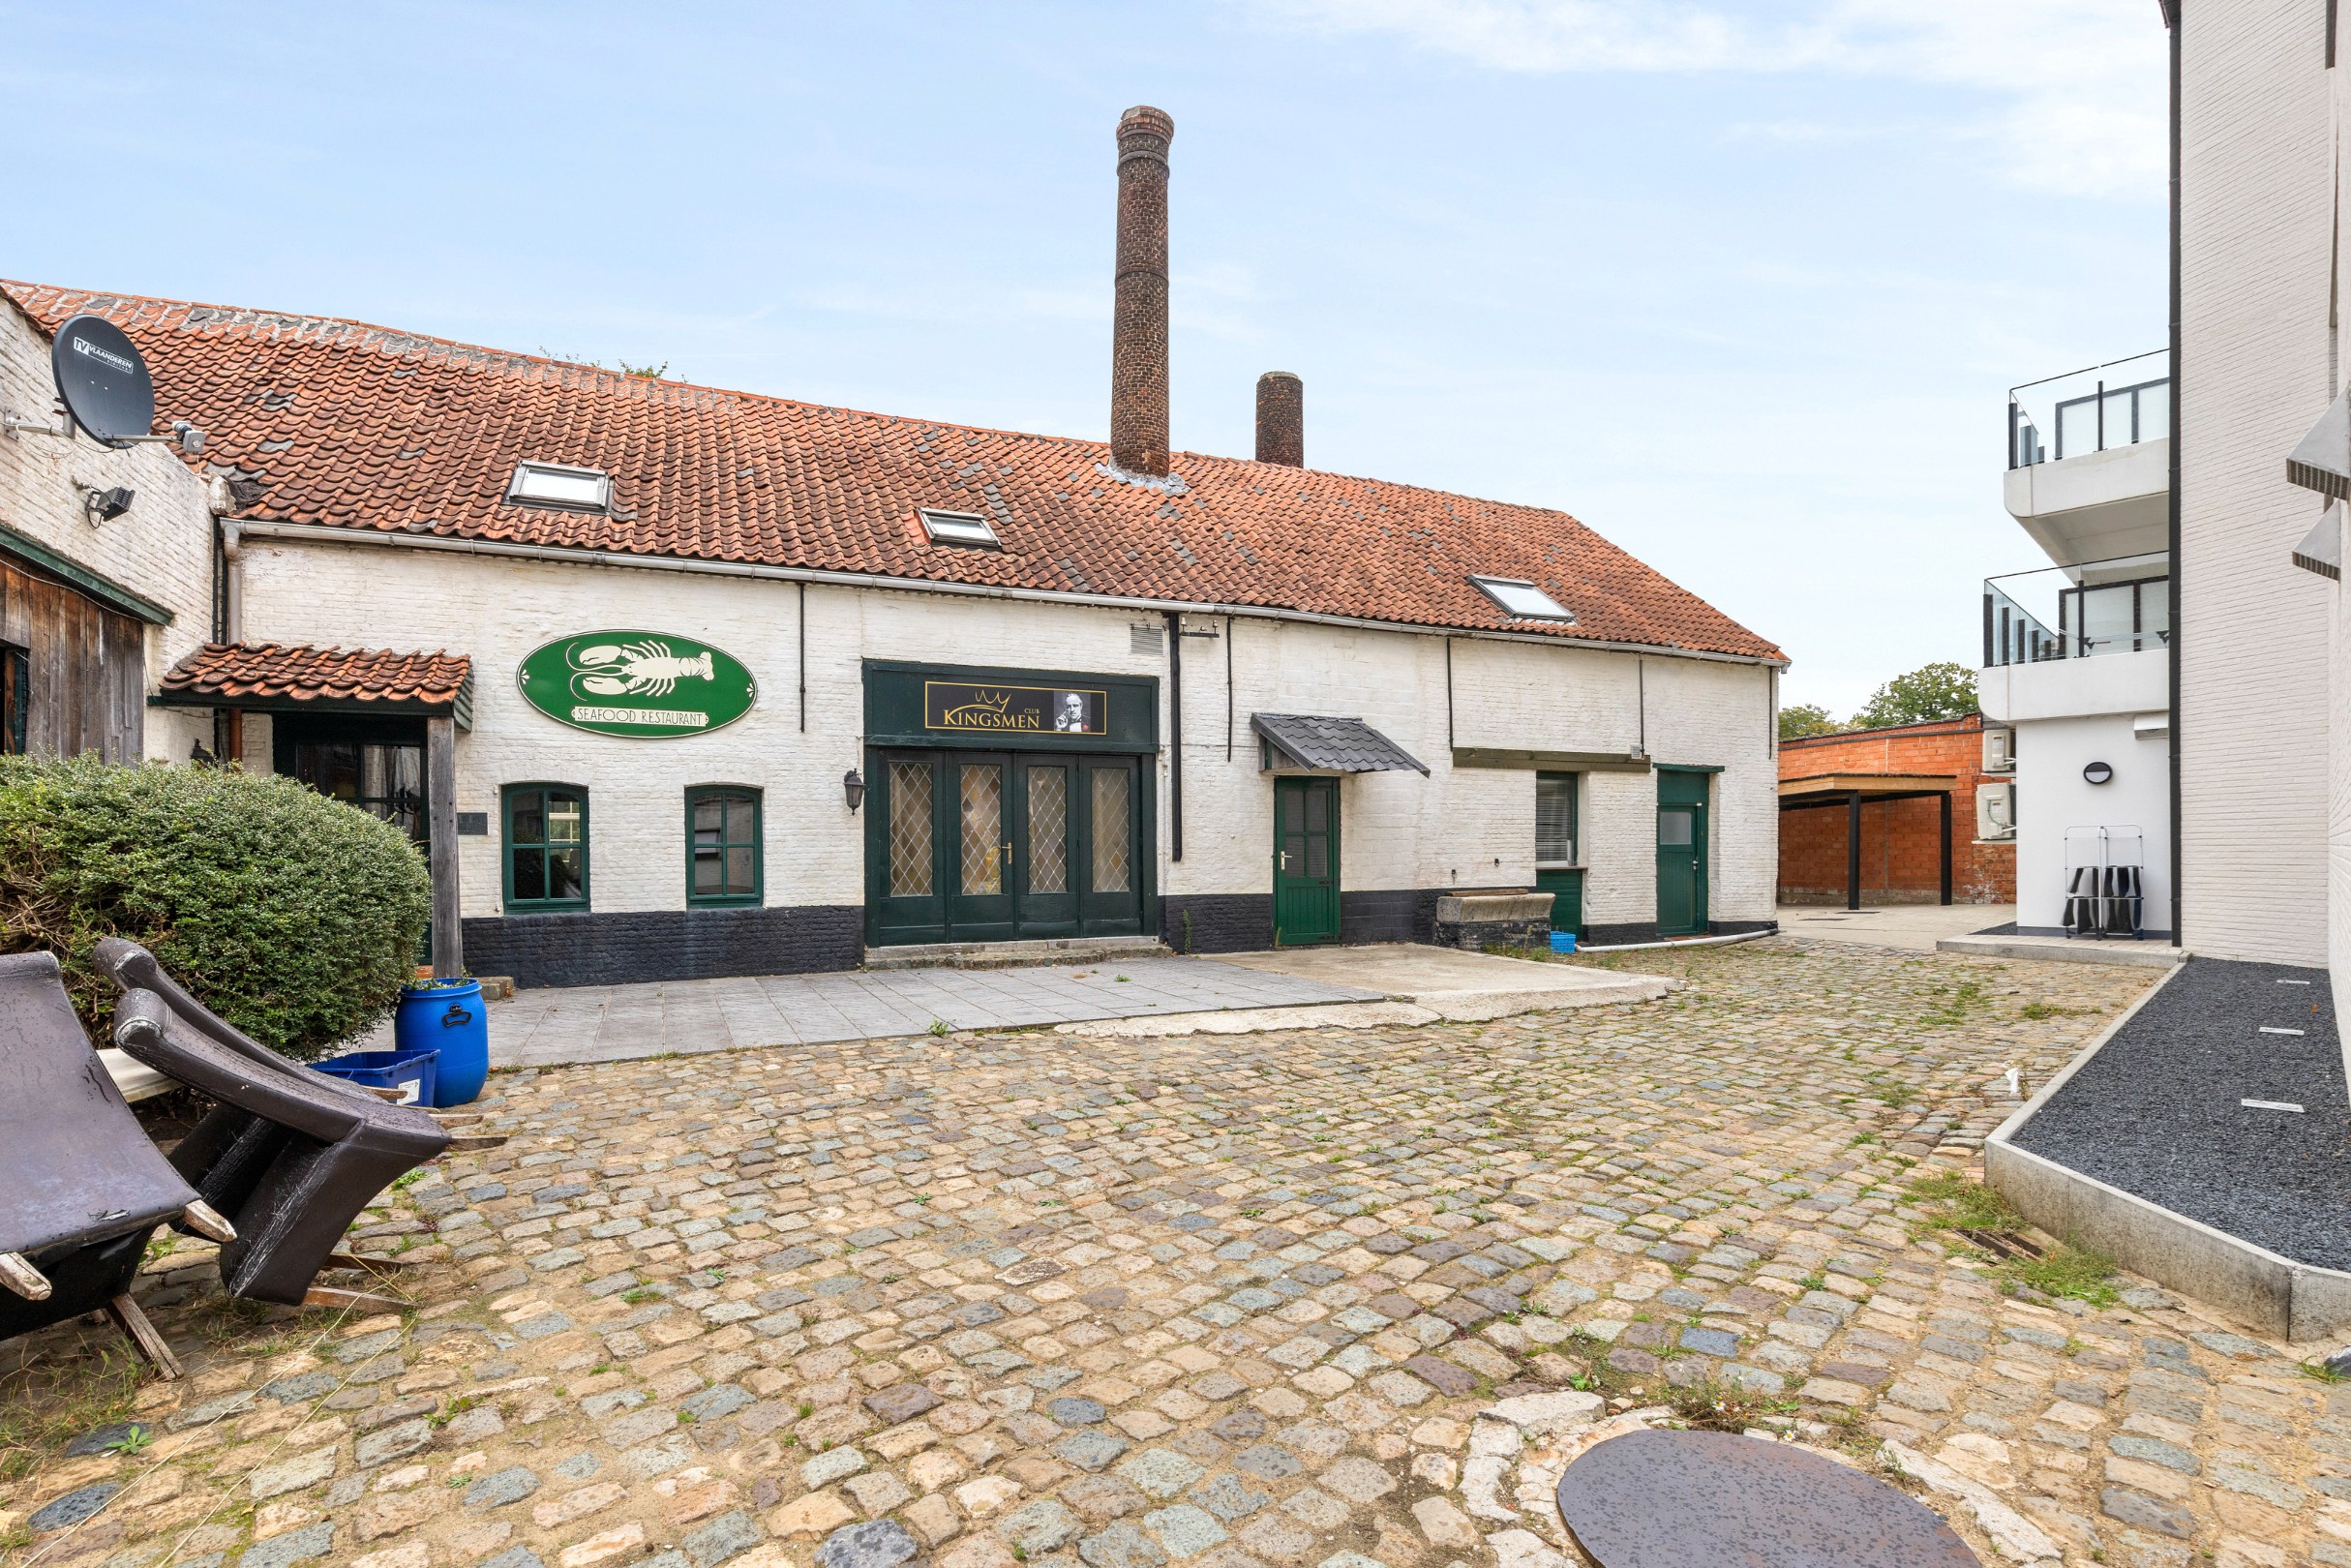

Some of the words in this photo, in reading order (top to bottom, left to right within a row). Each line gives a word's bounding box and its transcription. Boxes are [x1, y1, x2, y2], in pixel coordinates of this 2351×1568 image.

[75, 339, 87, 351] TV
[89, 346, 132, 368] VLAANDEREN
[577, 709, 636, 722] SEAFOOD
[642, 711, 703, 726] RESTAURANT
[944, 709, 1040, 728] KINGSMEN
